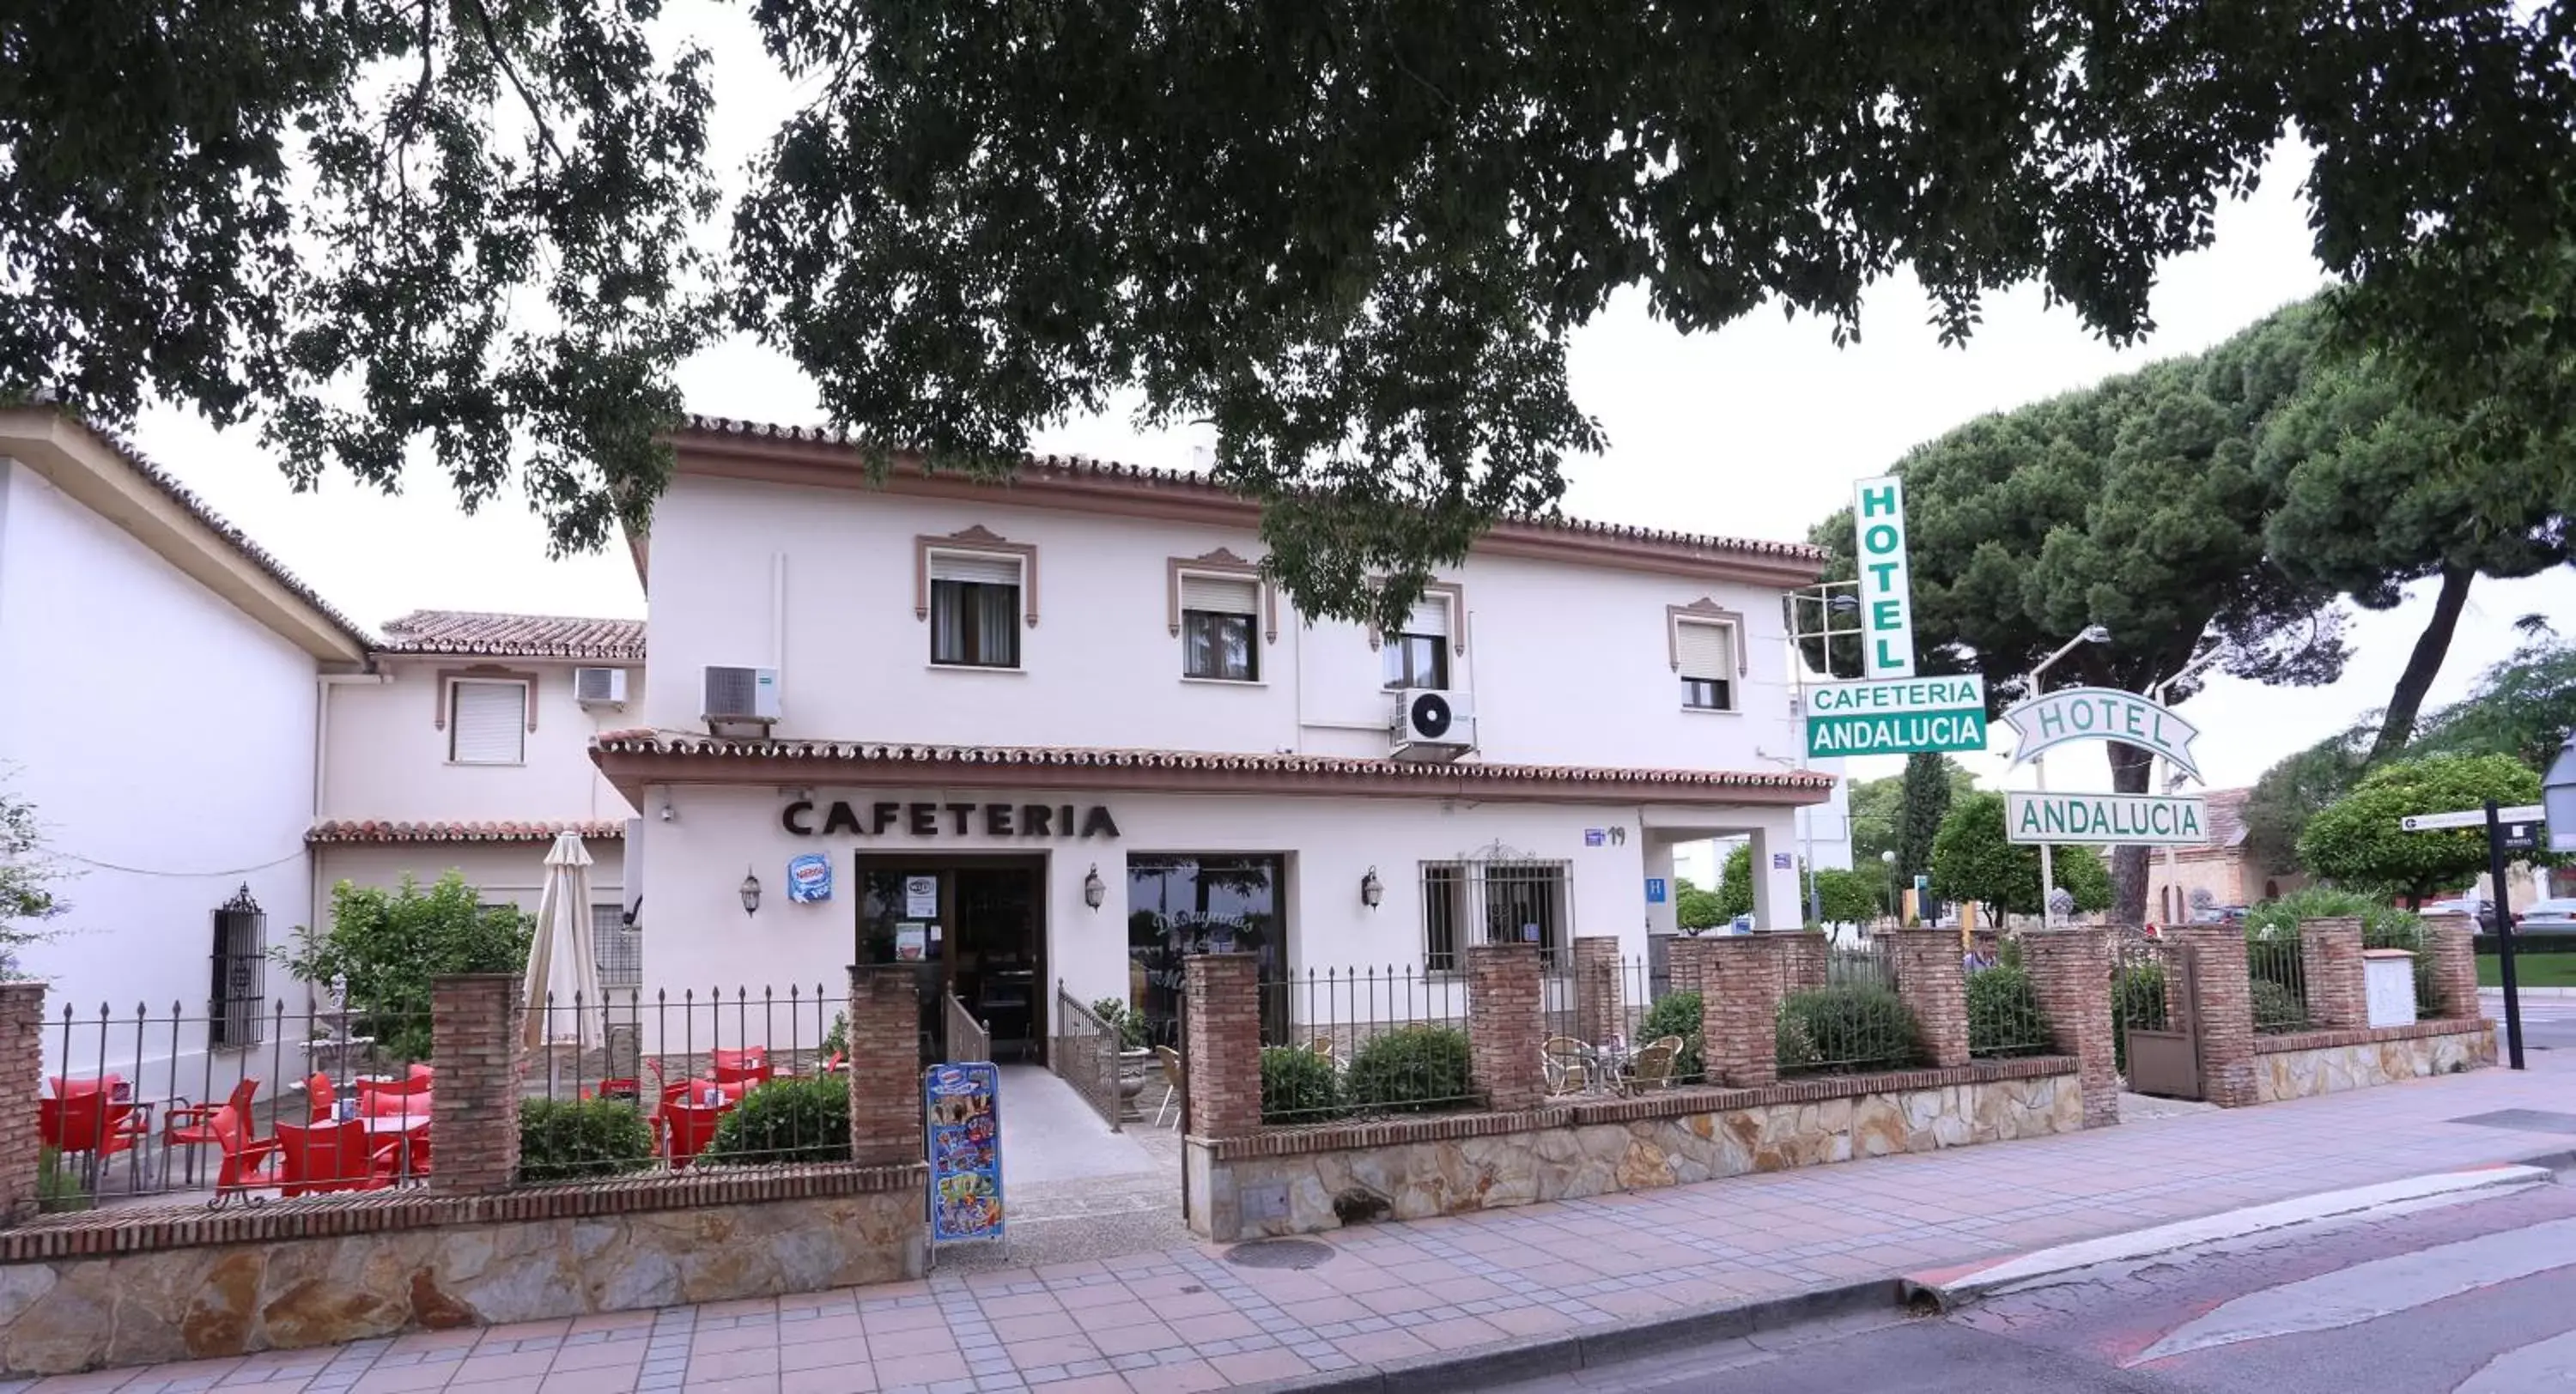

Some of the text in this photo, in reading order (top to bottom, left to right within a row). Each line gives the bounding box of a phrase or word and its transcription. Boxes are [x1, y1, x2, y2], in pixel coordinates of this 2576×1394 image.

[1862, 486, 1905, 669] HOTEL
[1814, 682, 1978, 710] CAFETERIA
[1814, 716, 1980, 751] ANDALUCIA
[2038, 699, 2172, 749] HOTEL
[782, 801, 1121, 837] CAFETERIA
[2020, 800, 2200, 836] ANDALUCIA
[1607, 826, 1625, 846] 19
[1649, 881, 1662, 894] H
